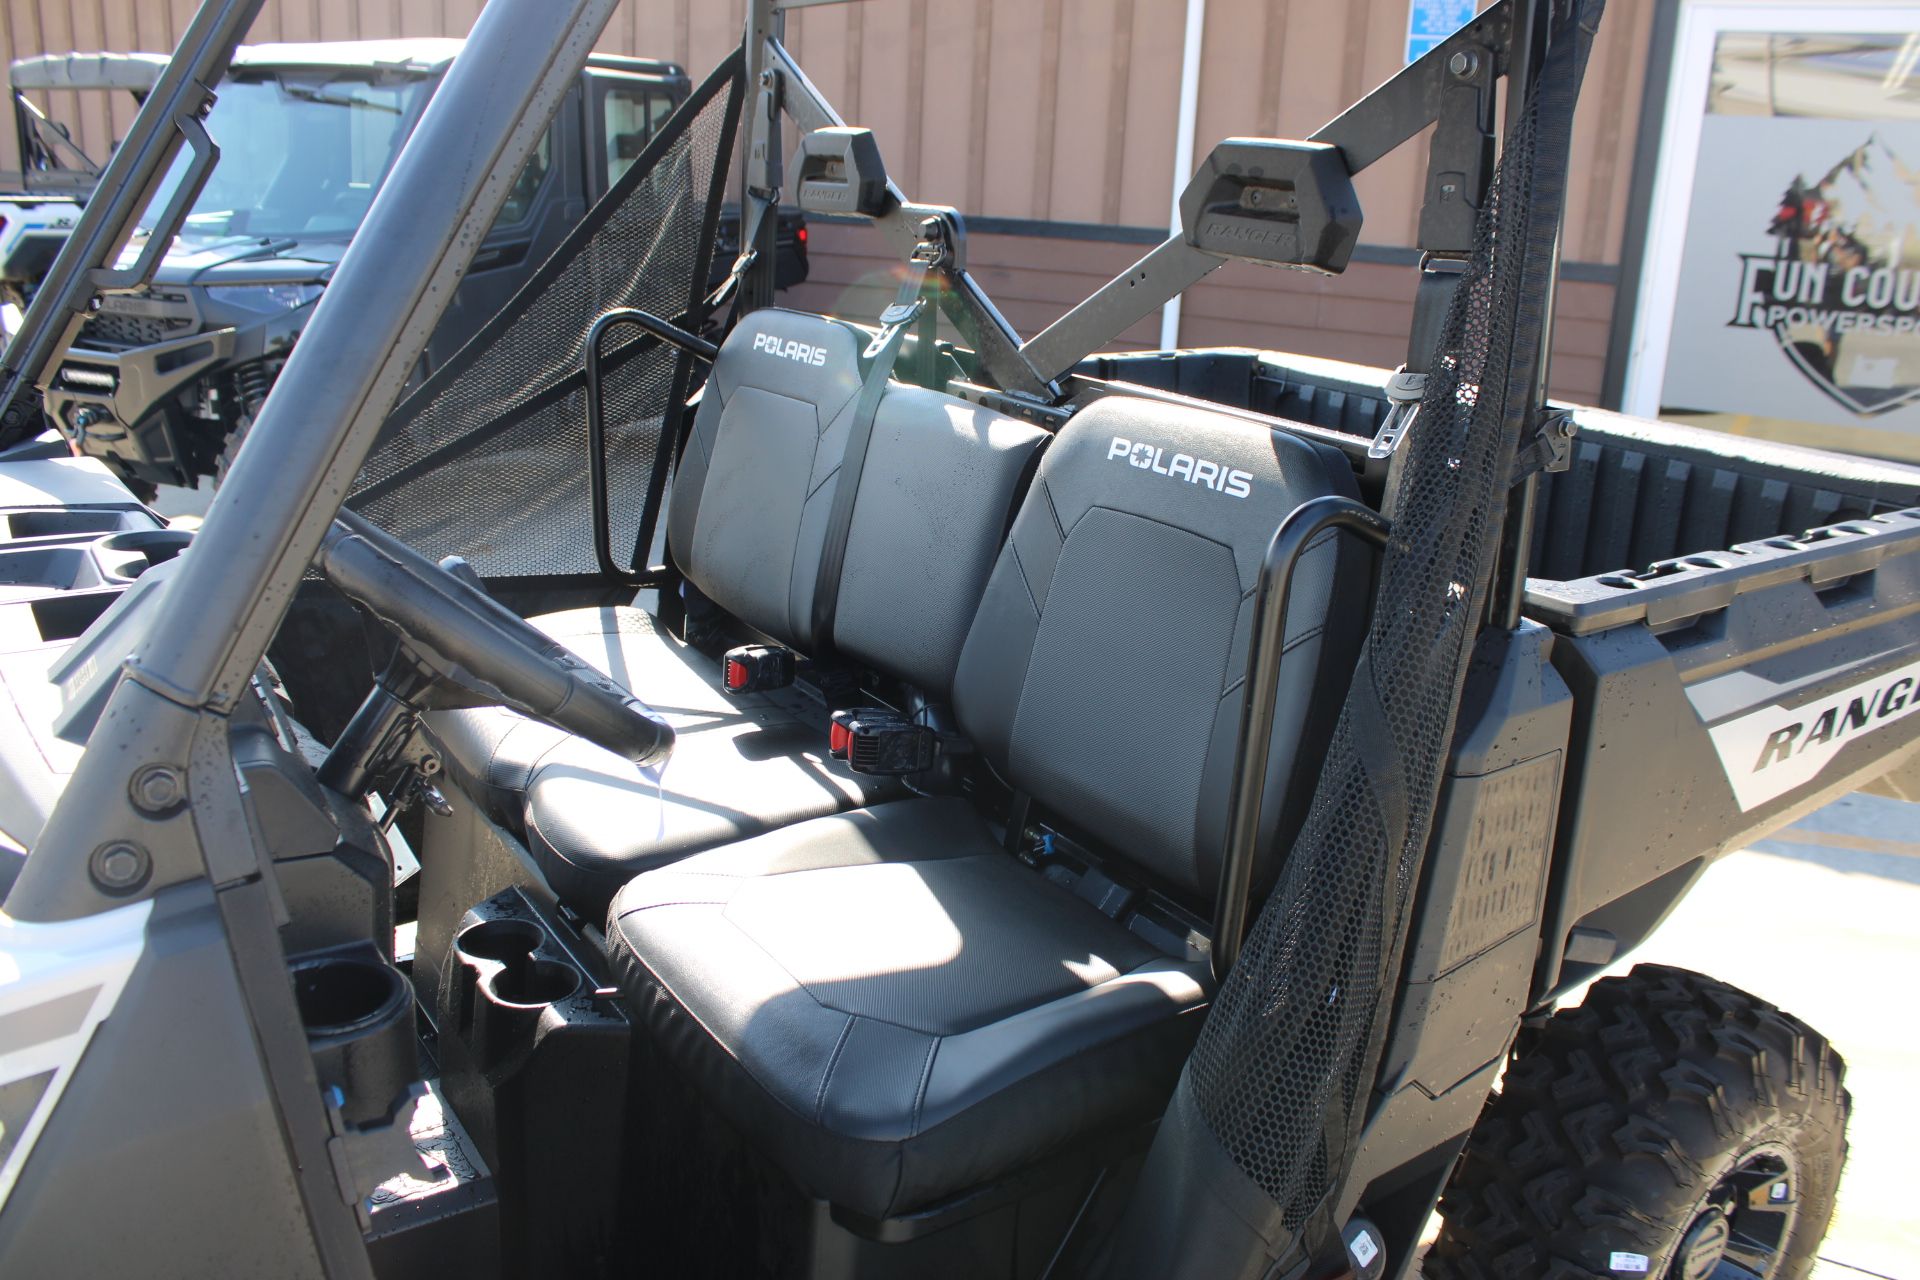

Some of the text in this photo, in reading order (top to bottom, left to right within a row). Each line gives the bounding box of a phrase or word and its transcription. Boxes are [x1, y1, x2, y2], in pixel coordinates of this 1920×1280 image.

[1206, 223, 1296, 246] RANGER
[1727, 254, 1828, 327] FUN
[1767, 305, 1920, 337] POWERSP
[753, 333, 827, 366] POLARIS
[1107, 437, 1253, 499] POLARIS
[1752, 677, 1920, 774] RANG
